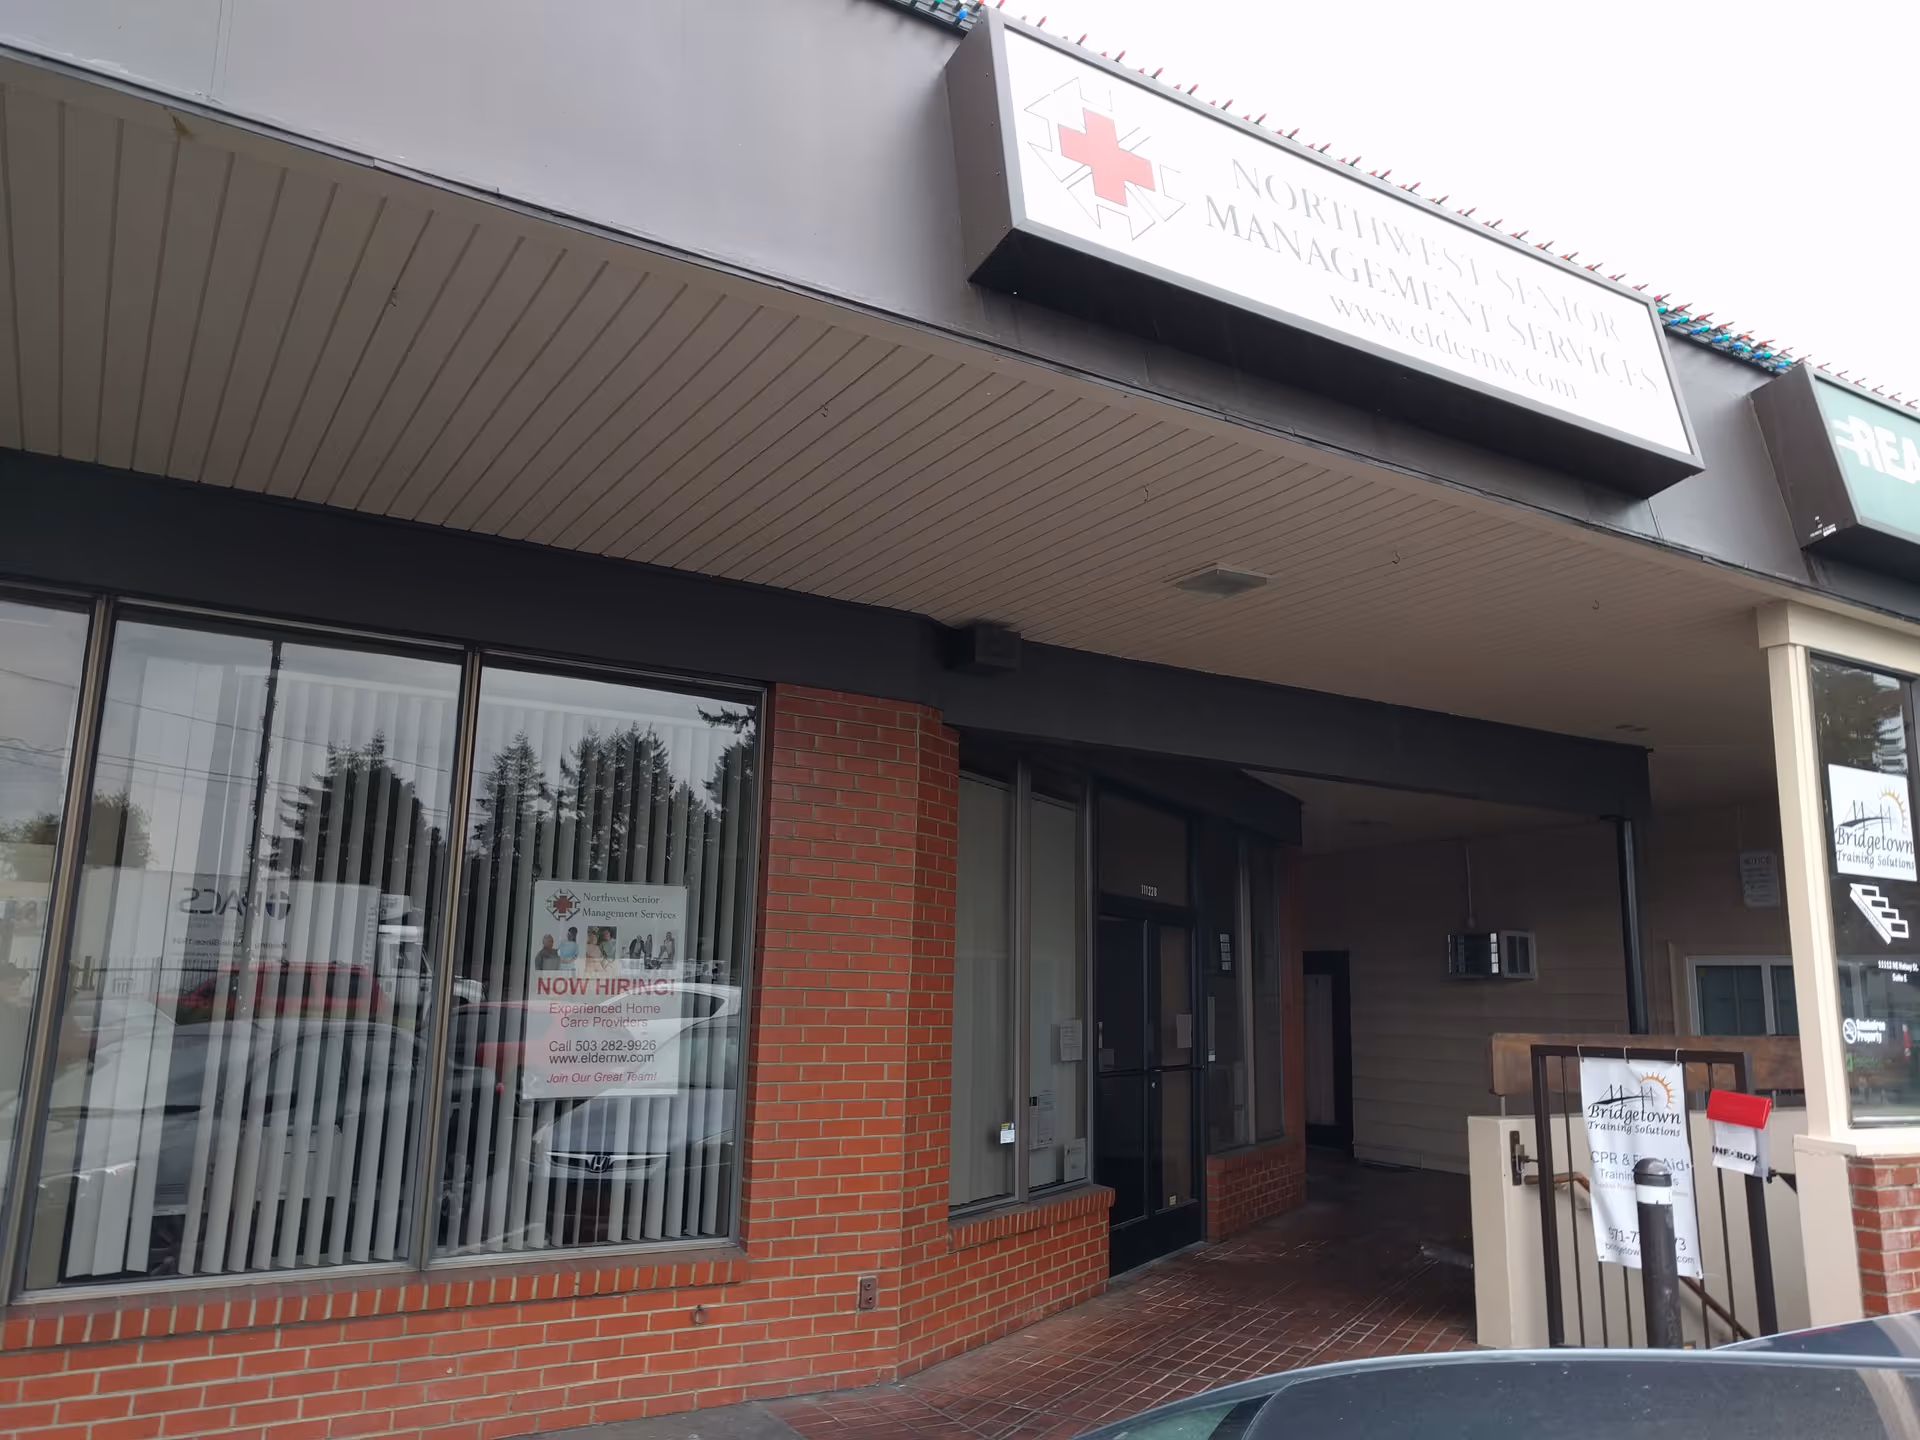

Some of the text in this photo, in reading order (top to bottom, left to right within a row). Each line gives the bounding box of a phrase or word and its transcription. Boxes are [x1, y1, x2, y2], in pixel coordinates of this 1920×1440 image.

[1231, 157, 1622, 343] NORTHWEST SENIOR
[1205, 194, 1660, 394] MANAGEMENT SERVICES
[1834, 826, 1914, 856] Bridgetown
[1836, 849, 1914, 871] Training Solutions
[583, 892, 660, 905] Northwest Senior
[582, 909, 677, 921] Management Services
[537, 977, 676, 996] NOW HIRING!
[549, 1003, 661, 1017] Experienced Home
[560, 1016, 648, 1028] Care Providers
[549, 1039, 657, 1052] Call 503 282-9926
[549, 1052, 655, 1064] www.eldernw.com
[546, 1071, 657, 1084] Join Our Great Team!
[1587, 1103, 1682, 1126] Bridgetown
[1587, 1120, 1681, 1138] Training Solutions
[1591, 1150, 1618, 1165] CPR
[1600, 1168, 1635, 1182] Trainin
